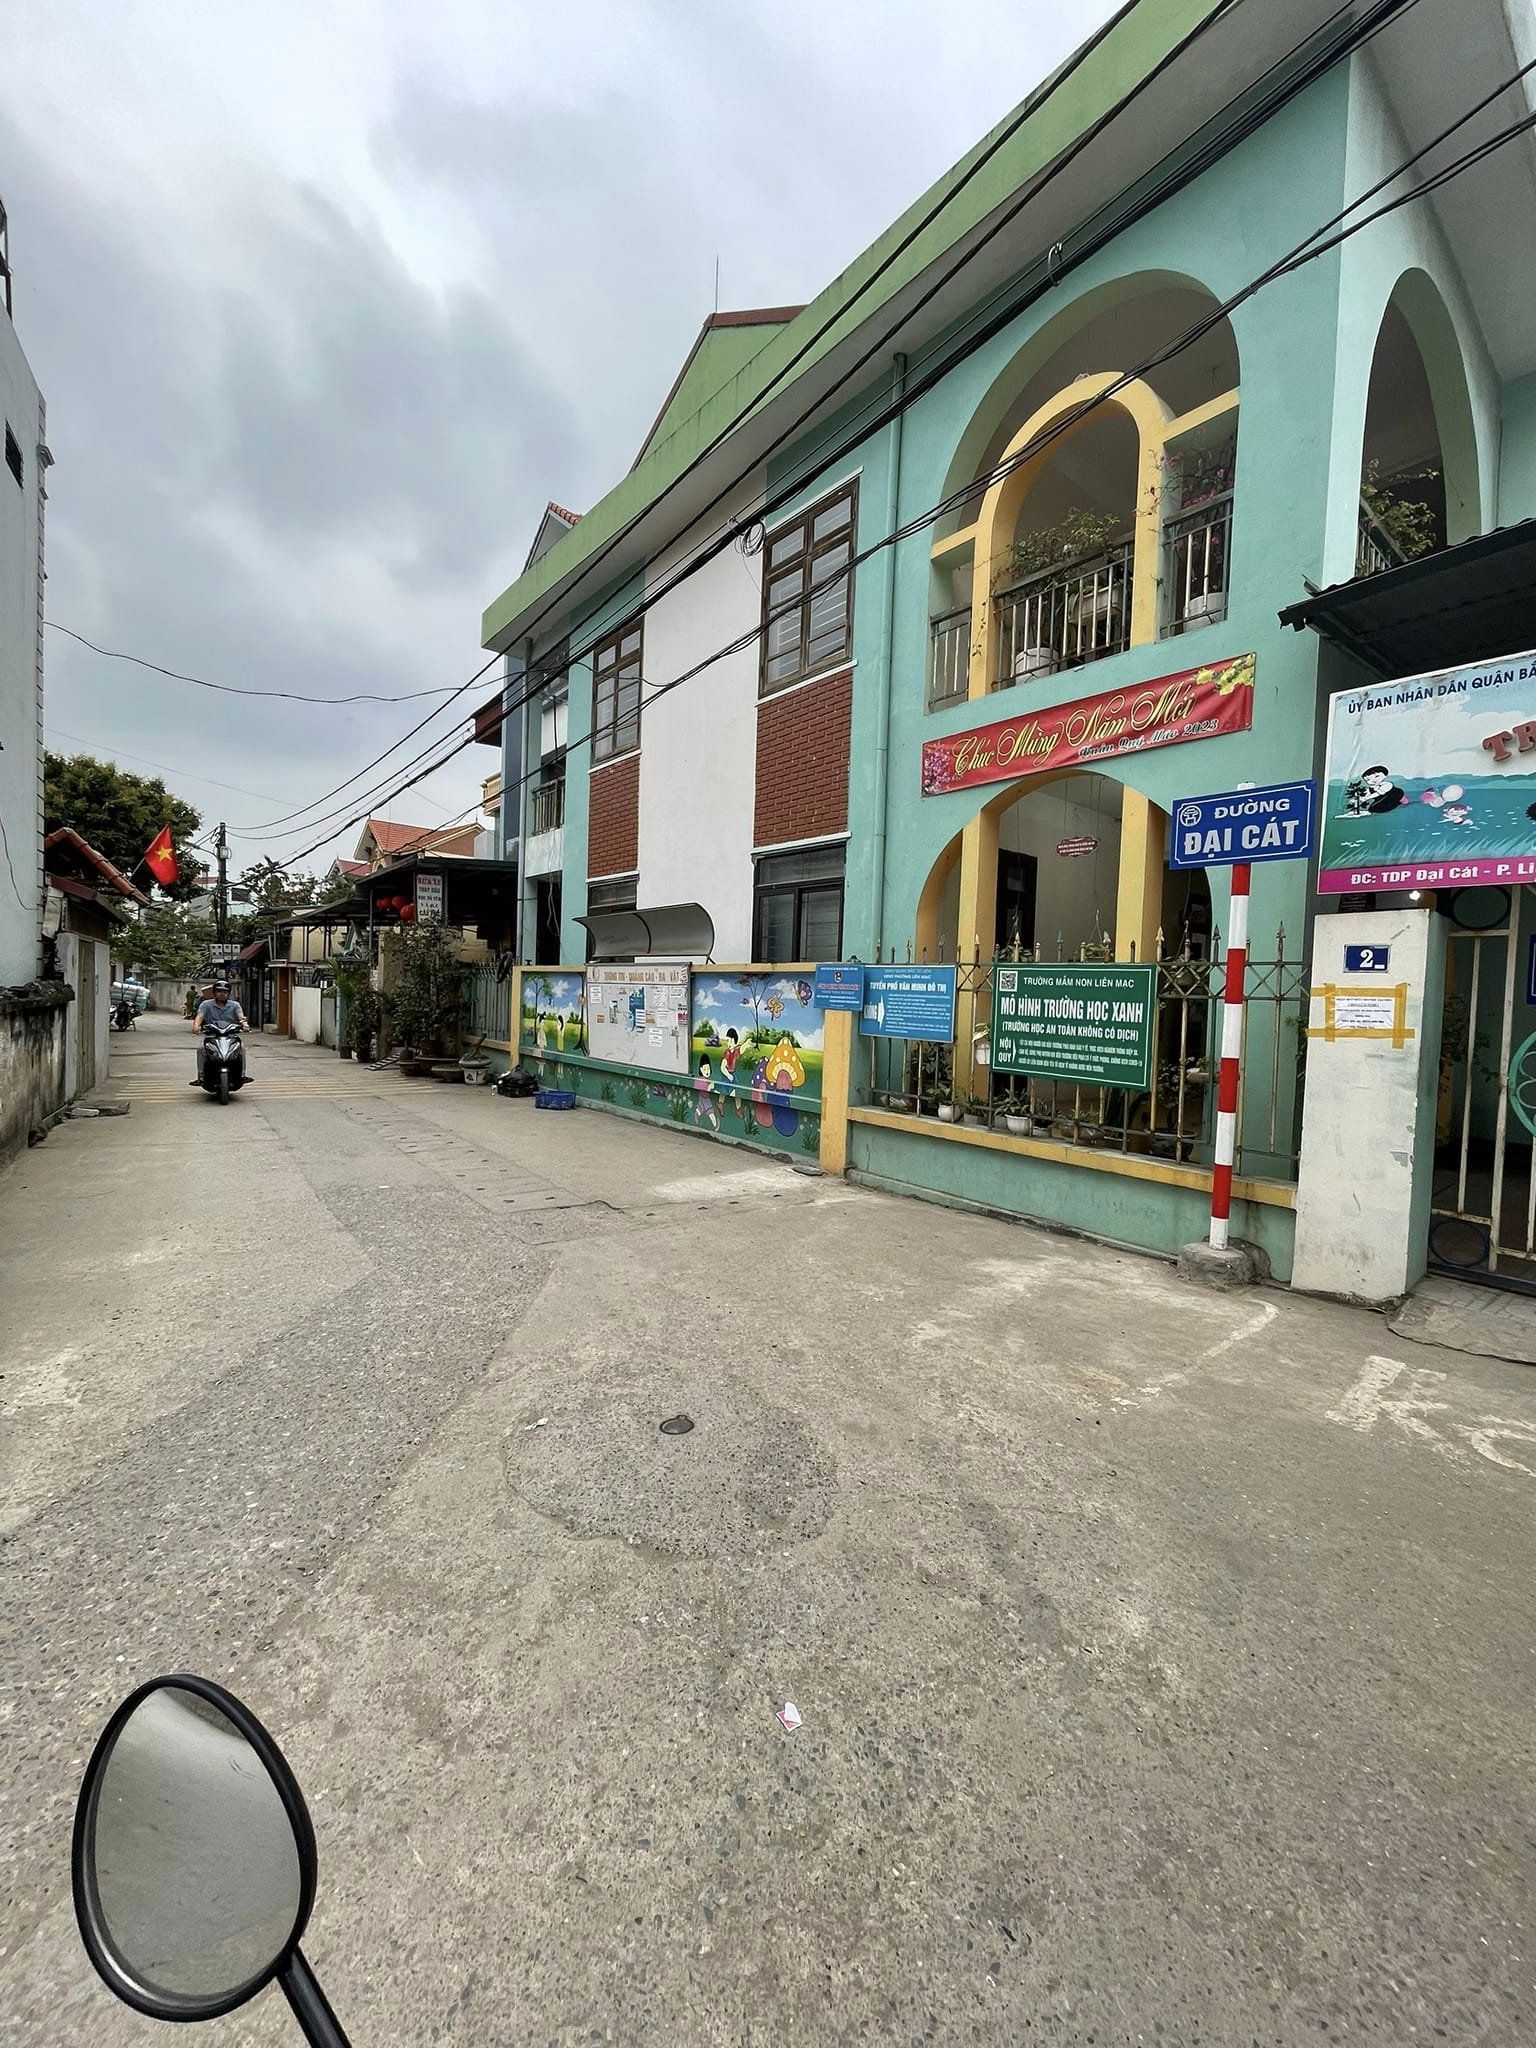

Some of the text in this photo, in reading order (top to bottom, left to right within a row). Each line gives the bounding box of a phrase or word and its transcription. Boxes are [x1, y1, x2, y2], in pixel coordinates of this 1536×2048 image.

[1348, 700, 1363, 713] ỦY
[1367, 696, 1392, 711] BAN
[1396, 687, 1433, 705] NHÂN
[1437, 679, 1467, 697] DÂN
[1471, 671, 1514, 689] QUẬN
[952, 682, 1196, 776] Chúc Mừng Năm Mới
[1182, 718, 1218, 735] 2023
[1214, 798, 1290, 819] ĐƯỜNG
[1184, 816, 1300, 858] ĐẠI CÁT
[1351, 873, 1376, 885] ĐC:
[1381, 871, 1411, 883] TDP
[1416, 868, 1443, 883] Đại
[1449, 866, 1479, 879] Cát
[1497, 864, 1511, 876] P.
[1359, 949, 1374, 967] 2
[887, 980, 898, 991] PHỐ
[1023, 975, 1135, 989] TRƯỜNG MẦM NON LIÊN MẠC
[1001, 994, 1144, 1025] MÔ HÌNH TRƯỜNG HỌC XANH
[1002, 1019, 1139, 1042] (TRƯỜNG HỌC AN TOÀN KHÔNG CÓ DỊCH)
[999, 1036, 1012, 1051] NỘI
[998, 1052, 1011, 1063] QUY
